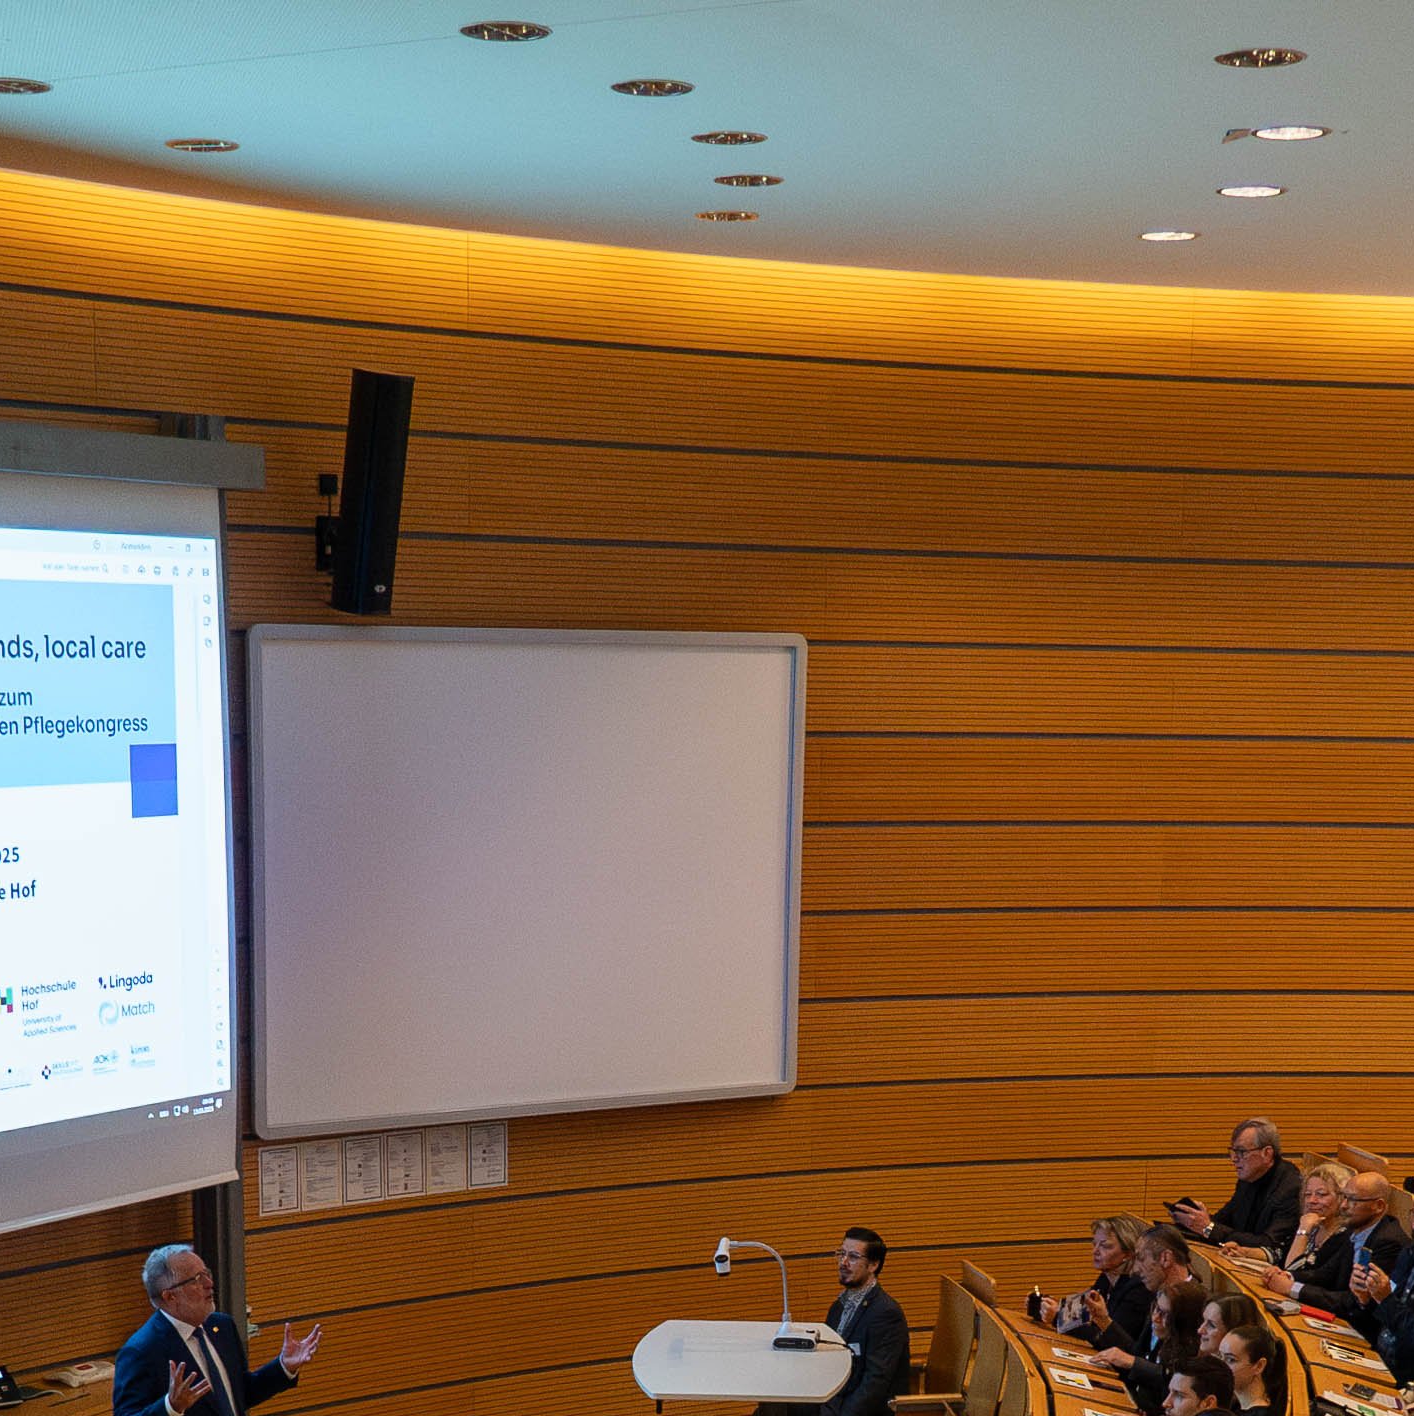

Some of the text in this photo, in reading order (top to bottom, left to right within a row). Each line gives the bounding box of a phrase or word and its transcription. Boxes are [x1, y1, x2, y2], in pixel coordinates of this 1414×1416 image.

[44, 635, 96, 659] local
[101, 638, 146, 659] care
[23, 714, 148, 739] Pflegekongress
[10, 880, 37, 898] Hof
[21, 980, 77, 996] Hochschule
[108, 972, 153, 992] Lingoda
[22, 999, 39, 1012] Hof
[121, 1001, 155, 1018] Match
